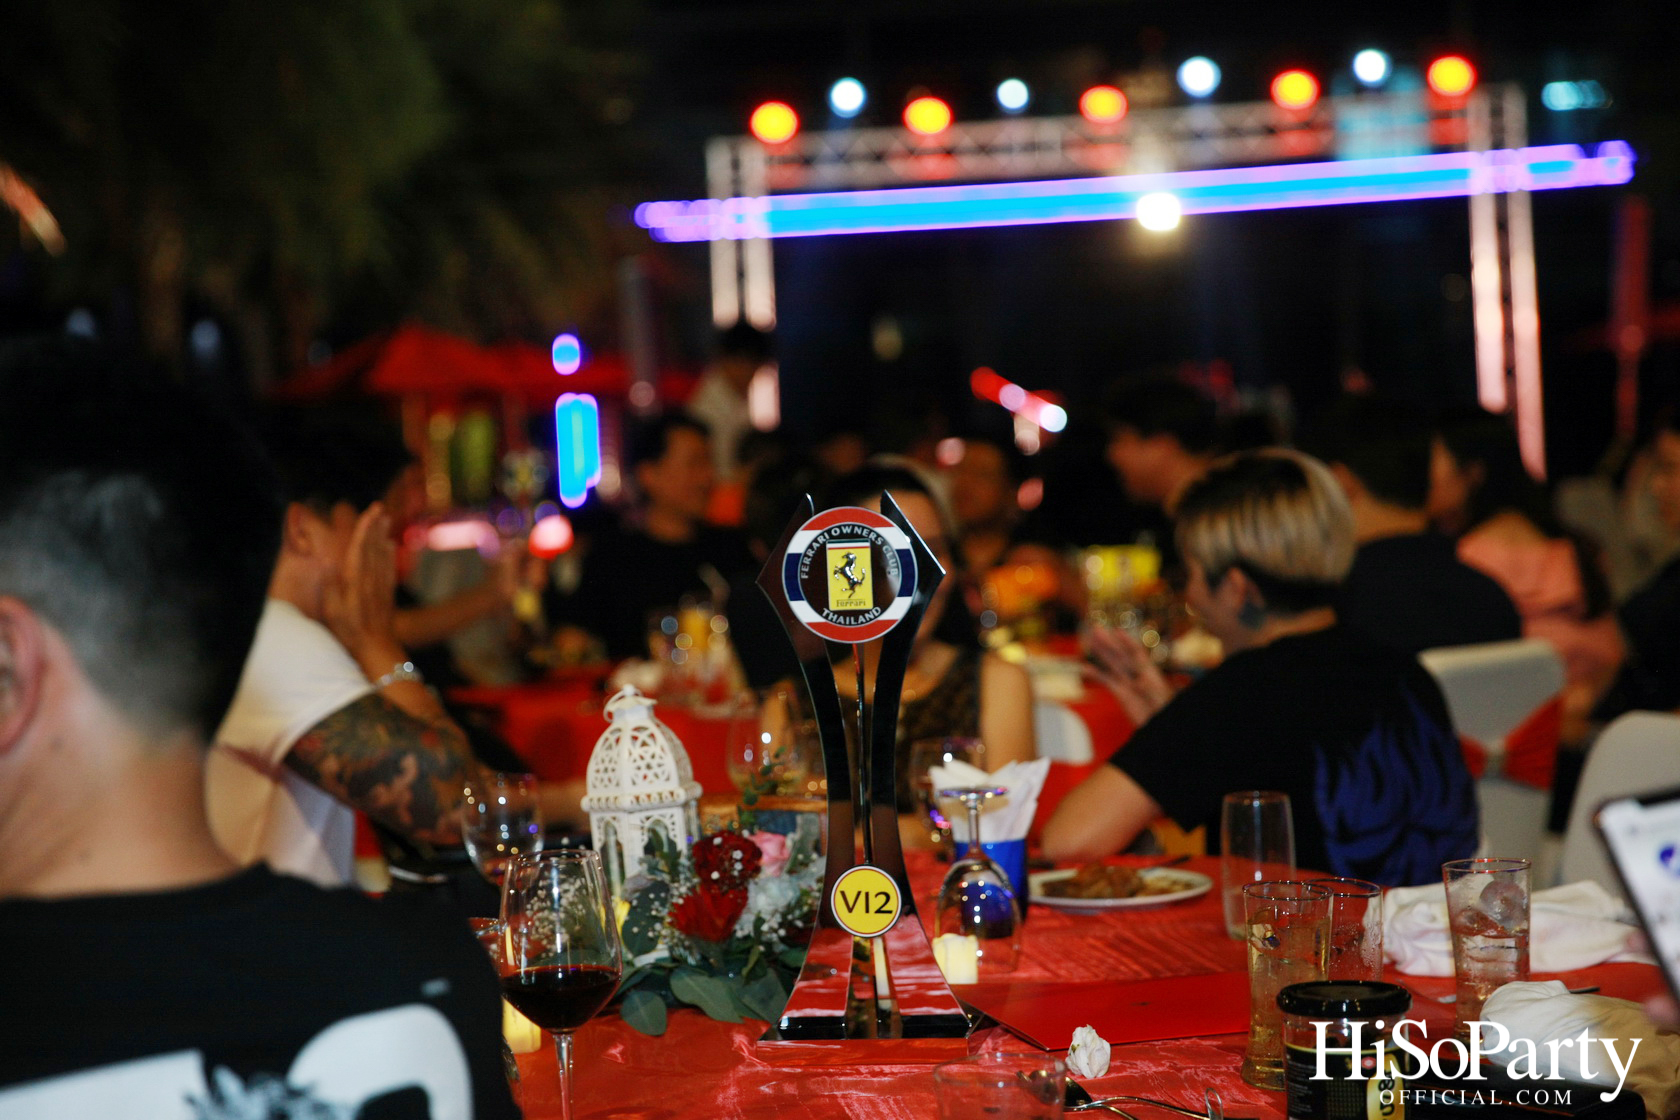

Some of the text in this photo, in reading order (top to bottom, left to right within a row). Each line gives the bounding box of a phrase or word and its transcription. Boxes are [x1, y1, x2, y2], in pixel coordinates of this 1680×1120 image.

[801, 525, 899, 579] FERRARI OWNERS CLUB
[836, 598, 866, 607] Ferrari
[821, 606, 882, 625] THAILAND
[839, 890, 894, 914] V12
